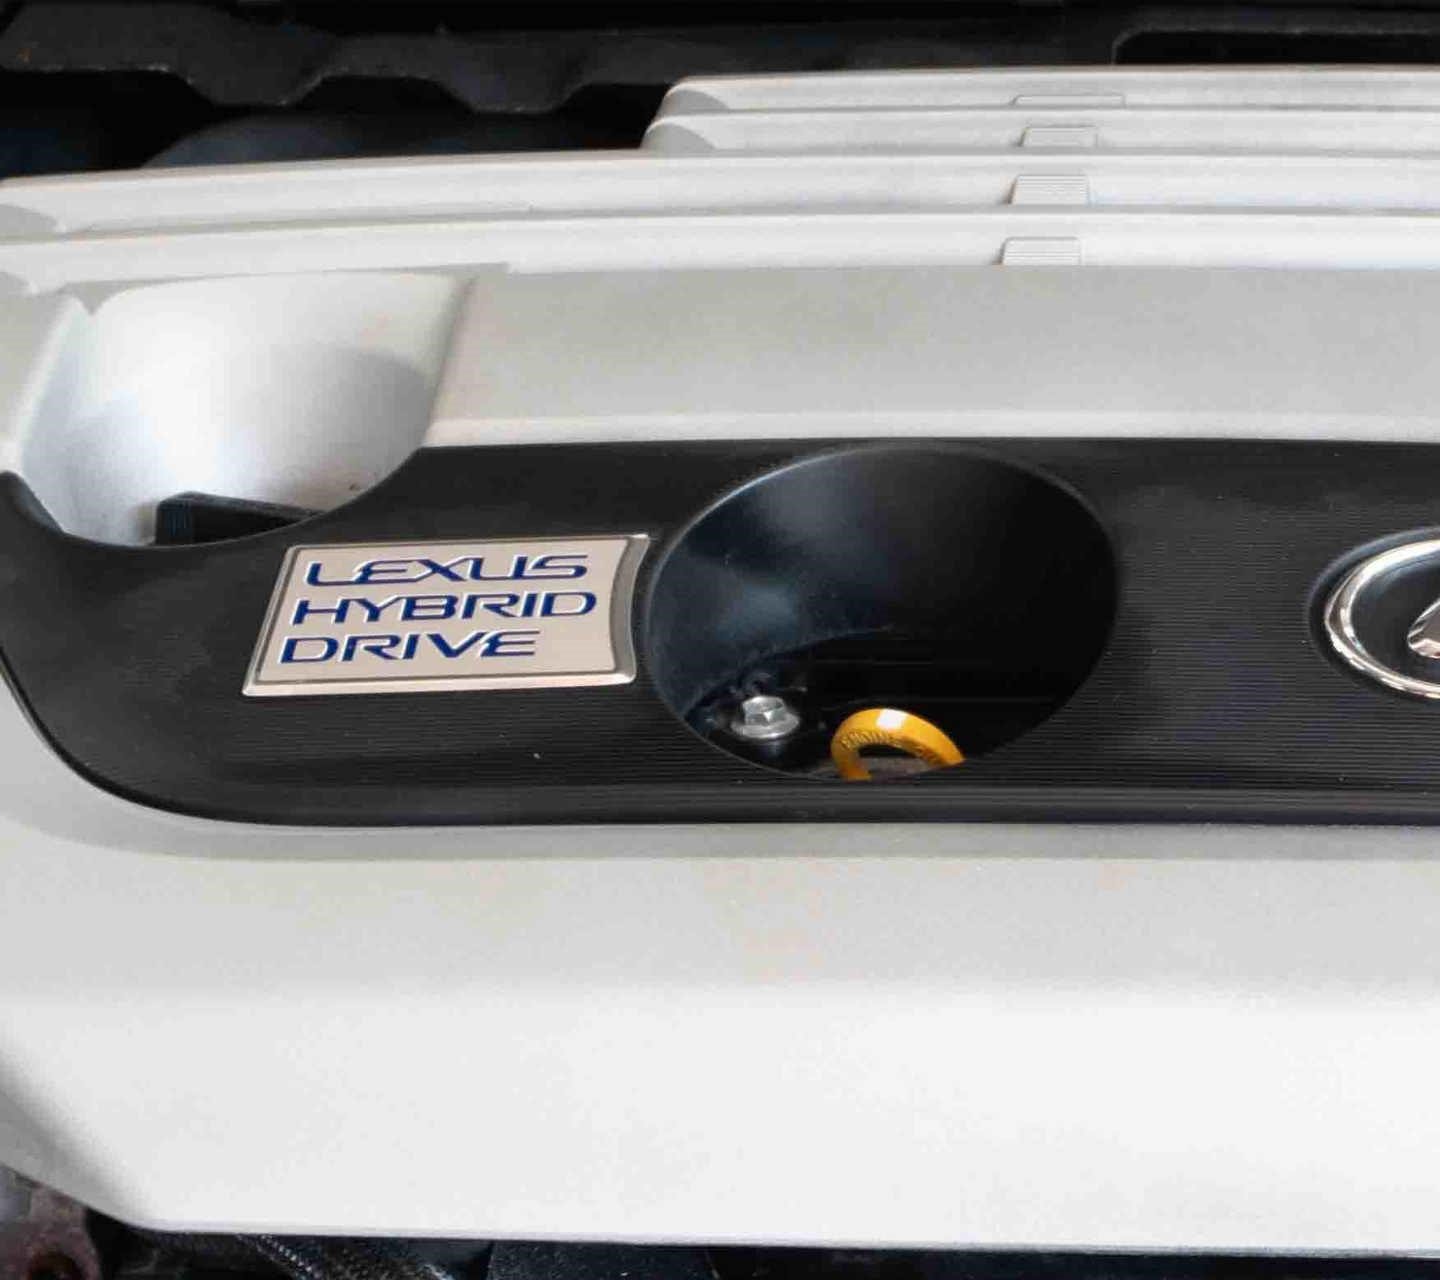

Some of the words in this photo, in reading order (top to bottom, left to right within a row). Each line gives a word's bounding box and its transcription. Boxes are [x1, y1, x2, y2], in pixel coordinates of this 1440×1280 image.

[306, 555, 589, 587] LEXUS
[292, 591, 597, 626] HYBRID
[279, 631, 540, 664] DRIVE
